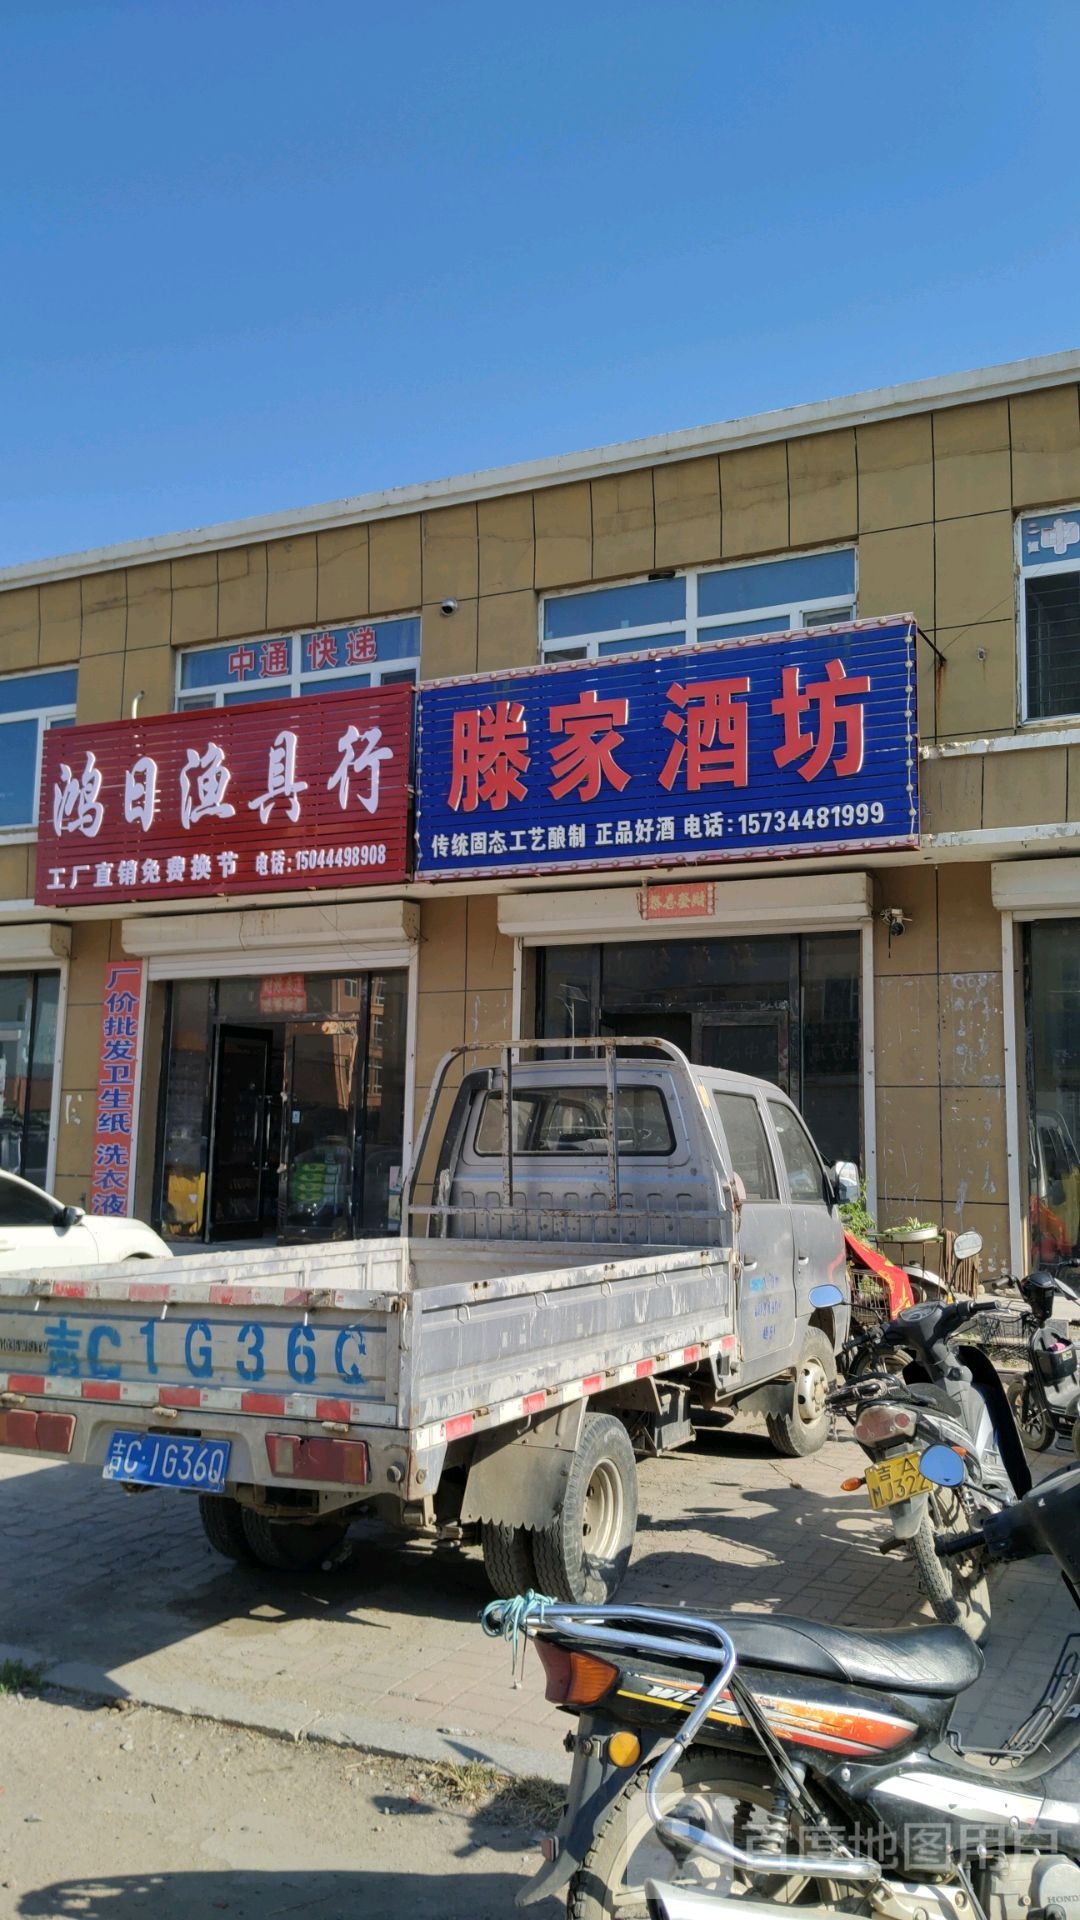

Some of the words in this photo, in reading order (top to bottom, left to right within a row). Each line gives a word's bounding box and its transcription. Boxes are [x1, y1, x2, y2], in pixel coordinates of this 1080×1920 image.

[228, 627, 377, 681] 中通快递
[448, 658, 870, 812] 滕家酒坊
[53, 725, 393, 838] 鸿日渔具行
[431, 825, 585, 859] 传统固态工艺酿制
[595, 815, 675, 846] 正品好酒
[46, 851, 238, 890] 工厂直销免费换节
[97, 968, 139, 1134] 厂价批发卫生纸
[92, 1145, 129, 1216] 洗衣液
[1047, 1893, 1080, 1904] HOND
